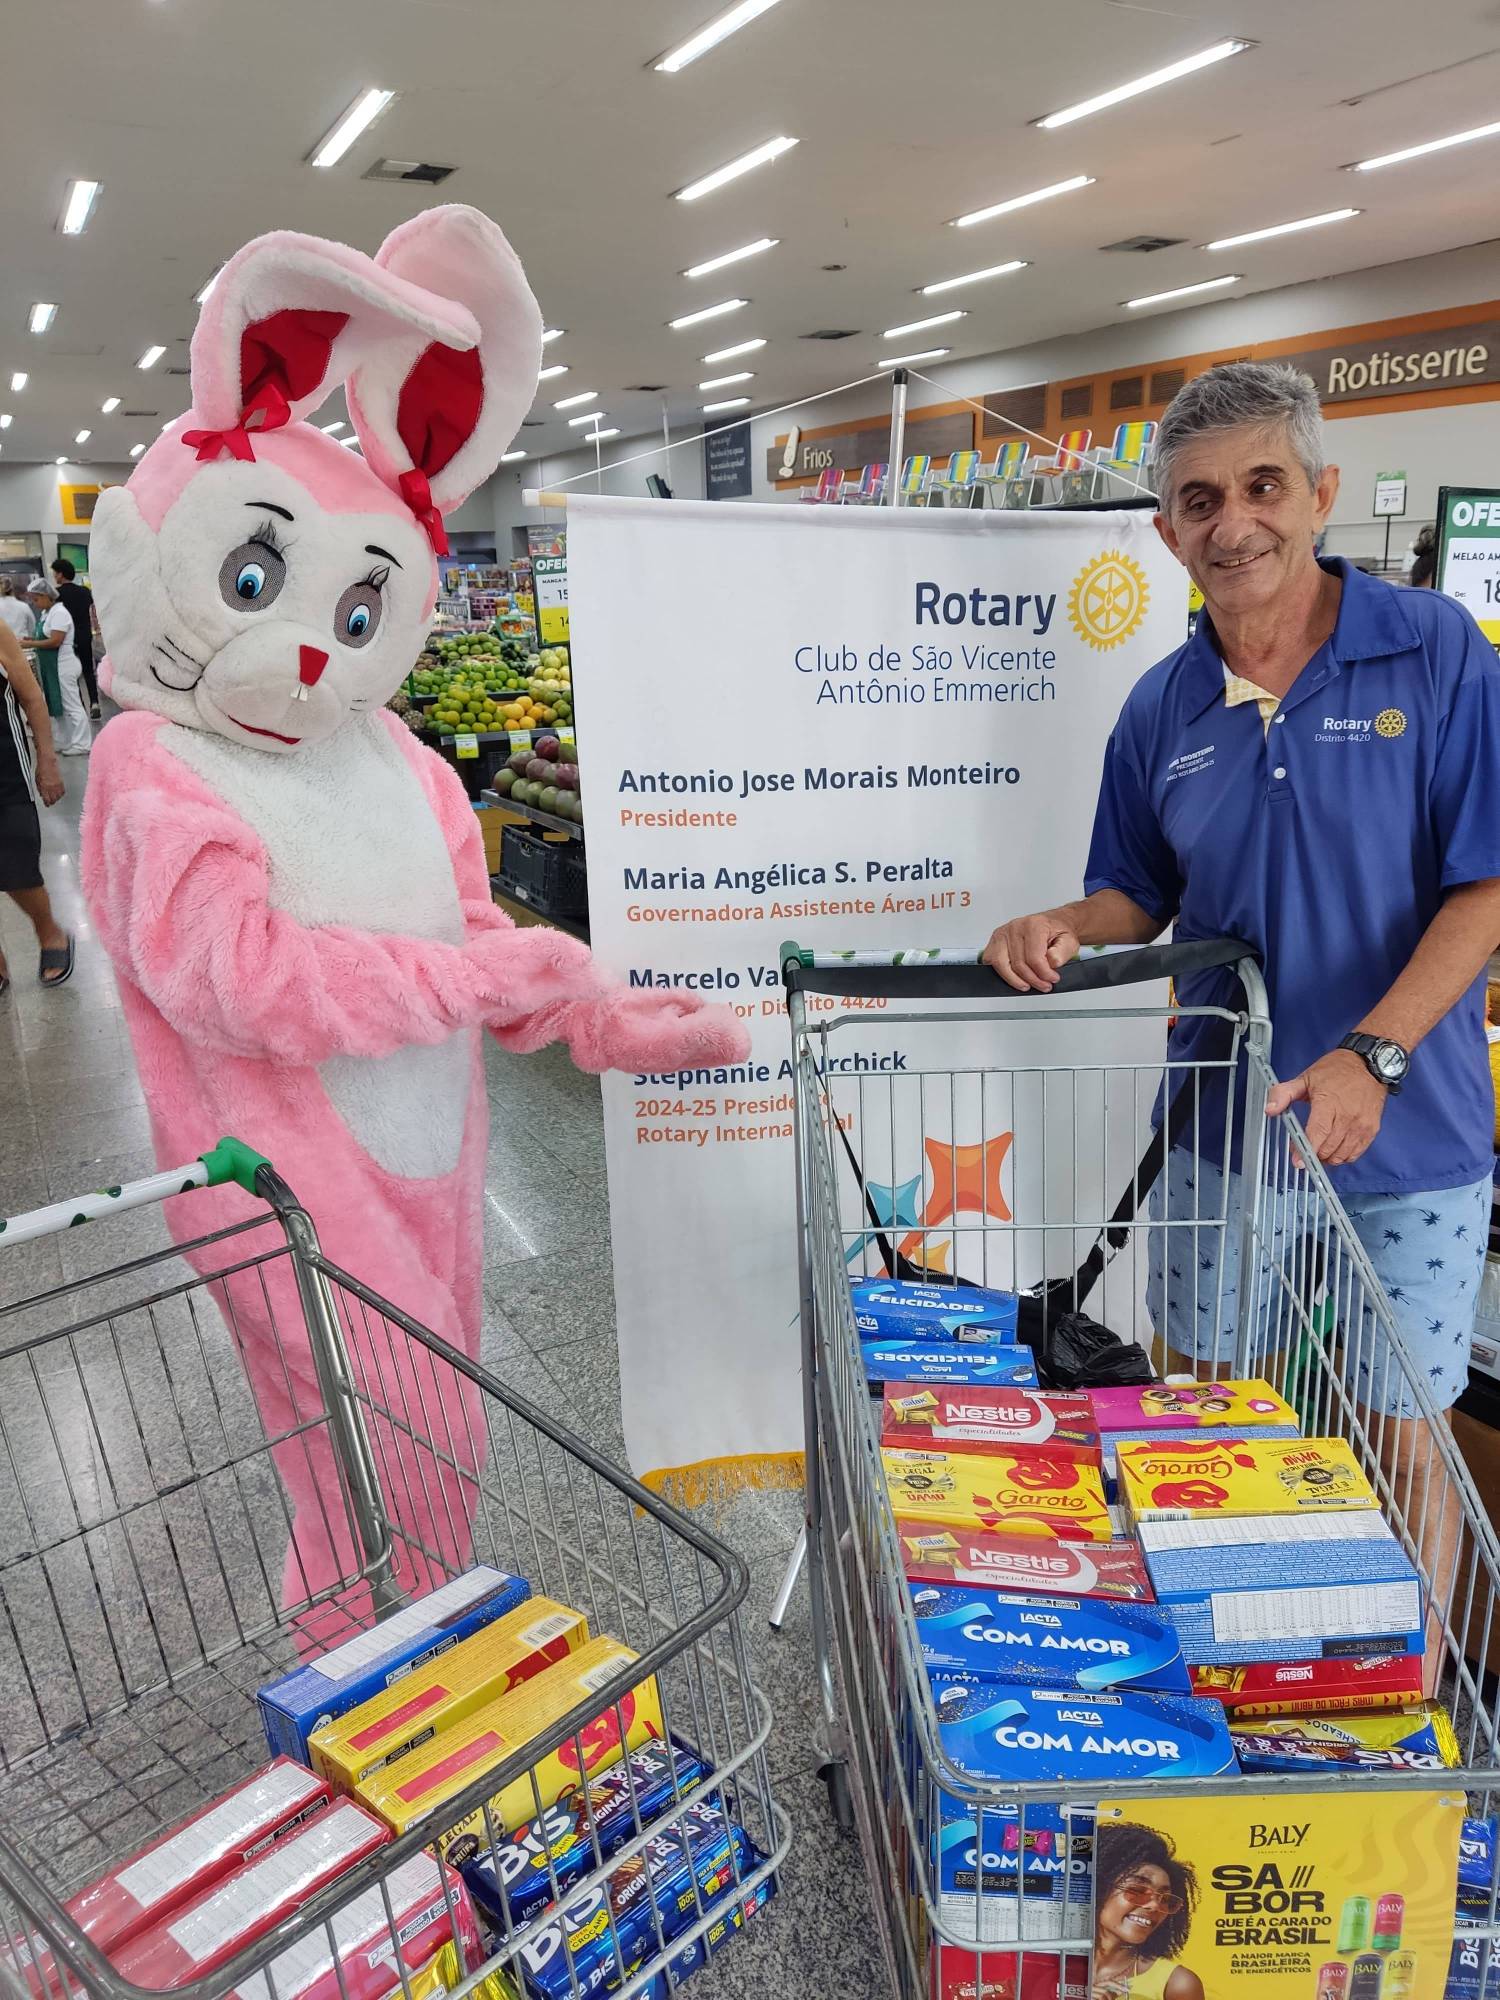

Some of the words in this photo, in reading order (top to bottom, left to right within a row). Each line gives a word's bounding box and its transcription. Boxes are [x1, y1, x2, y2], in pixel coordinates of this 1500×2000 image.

[1328, 344, 1488, 394] Rotisserie
[803, 446, 834, 470] Frios
[916, 581, 1056, 635] Rotary
[795, 645, 857, 672] Club
[868, 644, 901, 672] de
[912, 645, 952, 671] São
[962, 645, 1056, 671] Vicente
[816, 678, 925, 704] Antônio
[934, 675, 1055, 702] Emmerich
[1323, 717, 1372, 732] Rotary
[1314, 733, 1346, 743] Distrito
[1347, 733, 1371, 742] 4420
[619, 769, 733, 792] Antonio
[740, 769, 795, 798] Jose
[804, 765, 898, 790] Morais
[907, 762, 1020, 787] Monteiro
[620, 809, 737, 827] Presidente
[623, 867, 705, 889] Maria
[714, 863, 826, 894] Angélica
[835, 861, 857, 883] S.
[866, 857, 953, 882] Peralta
[627, 904, 764, 922] Governadora
[770, 899, 875, 919] Assistente
[881, 893, 925, 914] Área
[931, 892, 955, 910] LIT
[960, 891, 971, 907] 3
[629, 968, 740, 989] Marcelo
[748, 967, 781, 988] Va
[762, 996, 834, 1016] Disrito
[635, 1099, 717, 1118] 2024-25
[724, 1094, 833, 1116] Presidete
[637, 1125, 708, 1147] Rotary
[868, 1294, 985, 1313] FELICIDADES
[873, 1353, 998, 1365] FELICIDADES
[1144, 1459, 1232, 1479] Garoto
[996, 1489, 1086, 1508] Garoto
[1020, 1612, 1062, 1627] LACTA
[963, 1624, 1034, 1647] COM
[1039, 1634, 1131, 1656] AMOR
[1057, 1710, 1104, 1725] LACTA
[995, 1726, 1073, 1752] COM
[1080, 1735, 1181, 1759] AMOR
[1294, 1740, 1350, 1748] ORIGINAL
[582, 1789, 631, 1831] OIGINAL
[1249, 1823, 1311, 1849] BALY
[965, 1849, 1020, 1869] COM
[1225, 1890, 1325, 1914] BOR
[572, 1910, 609, 1948] CROCANTE
[1215, 1917, 1244, 1928] QUE
[1246, 1915, 1254, 1927] É
[1256, 1917, 1266, 1927] A
[1269, 1917, 1308, 1927] CARA
[1311, 1916, 1332, 1926] DO
[1215, 1927, 1331, 1946] BRASIL
[1231, 1958, 1311, 1968] BRASILEIRA
[1246, 1966, 1311, 1974] ENERGÉTICOS
[1322, 1968, 1346, 1977] BALY
[1354, 1963, 1382, 1975] BALY
